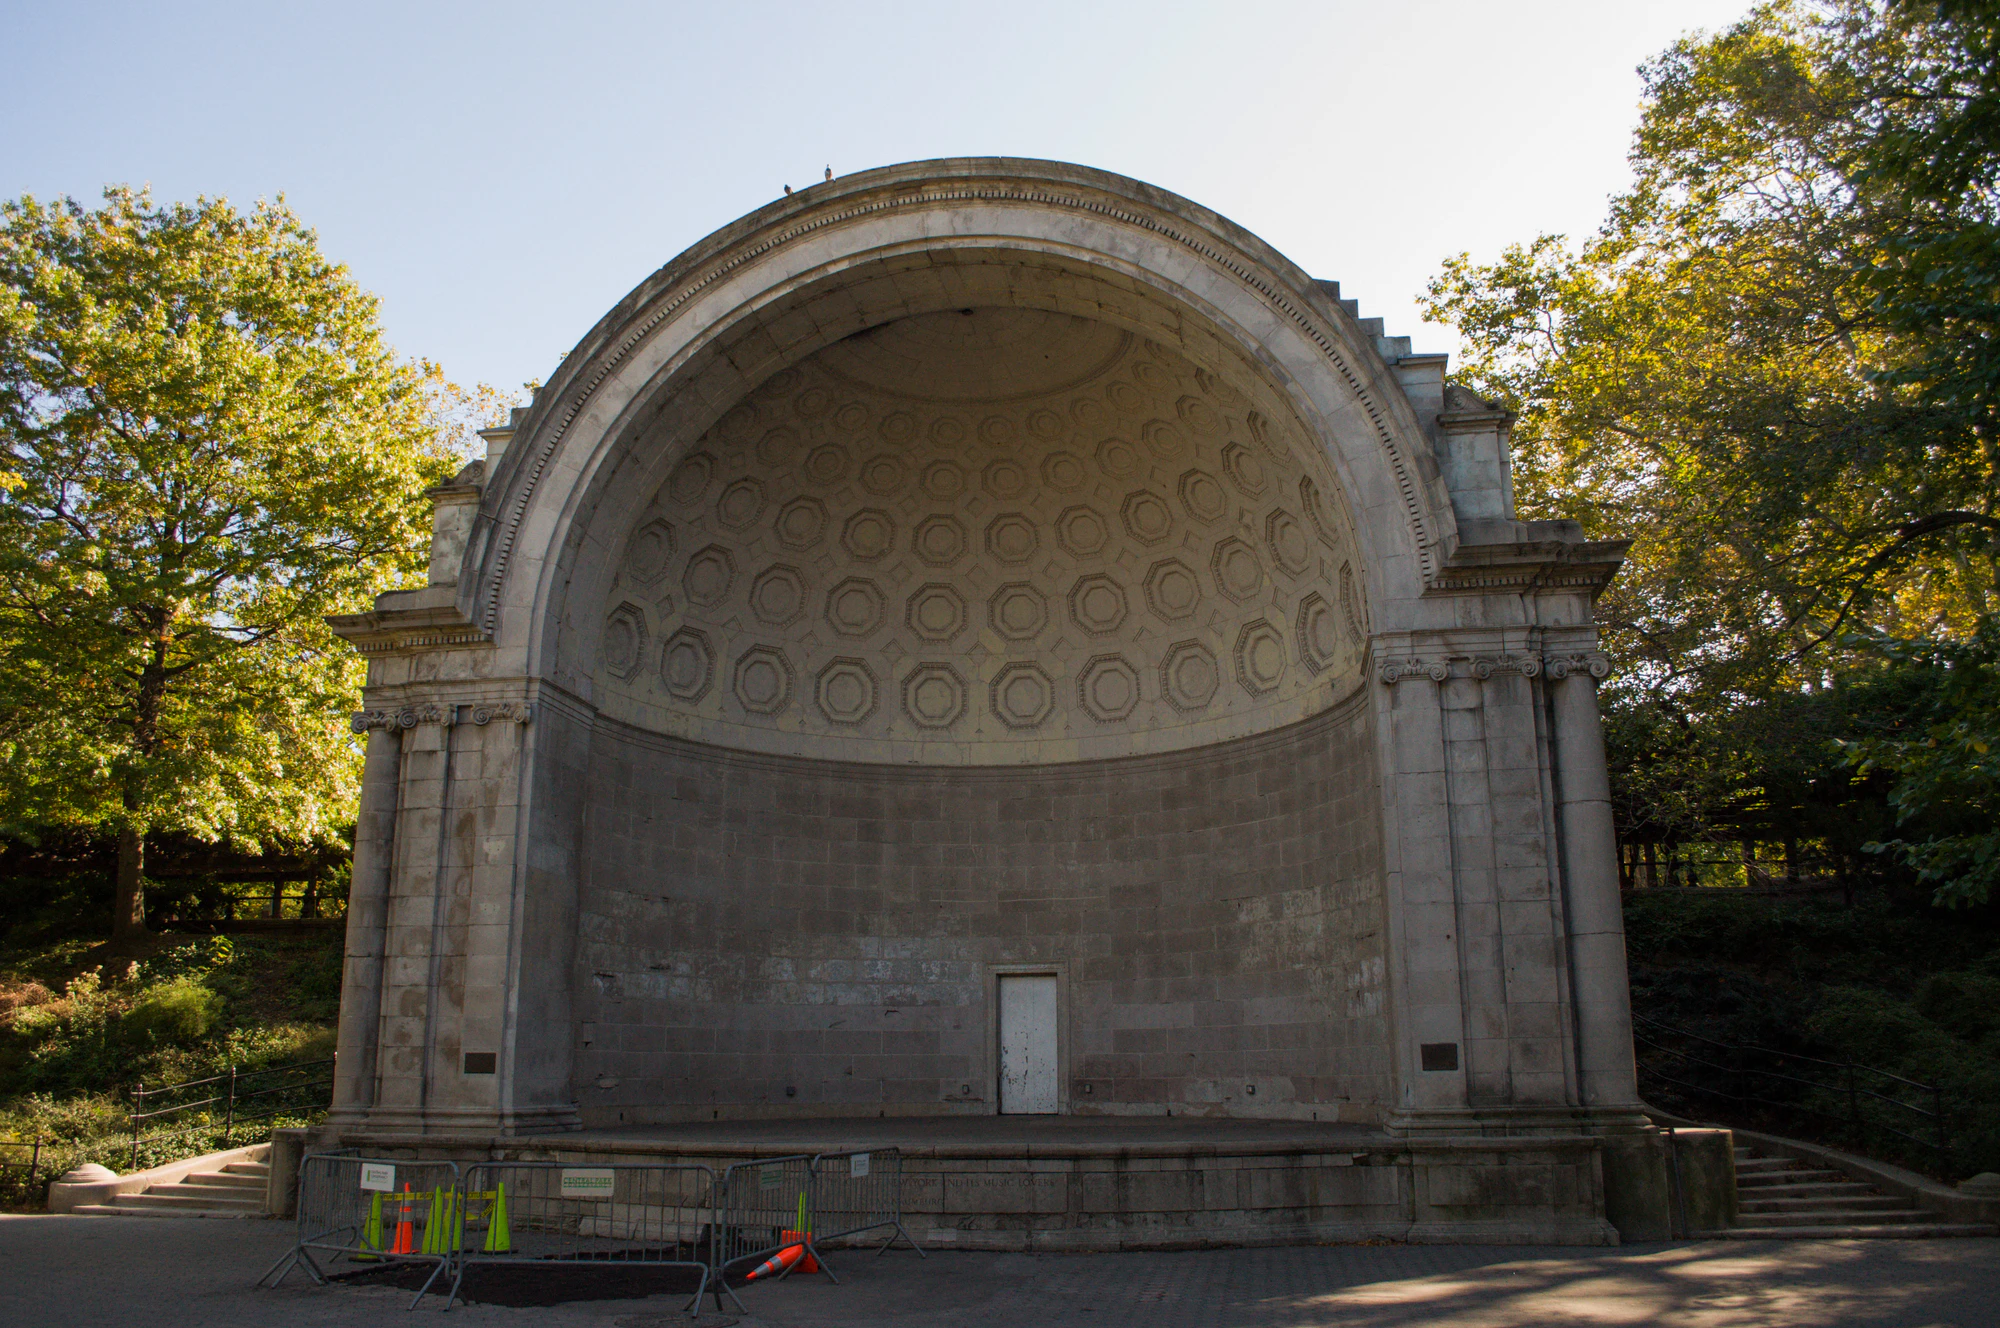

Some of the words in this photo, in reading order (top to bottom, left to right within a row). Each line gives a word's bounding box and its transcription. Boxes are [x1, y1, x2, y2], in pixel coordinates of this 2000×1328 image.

[563, 1177, 593, 1185] CENTRAL
[595, 1177, 613, 1185] PARK
[912, 1178, 938, 1188] YORK
[983, 1178, 1015, 1187] MUSIC
